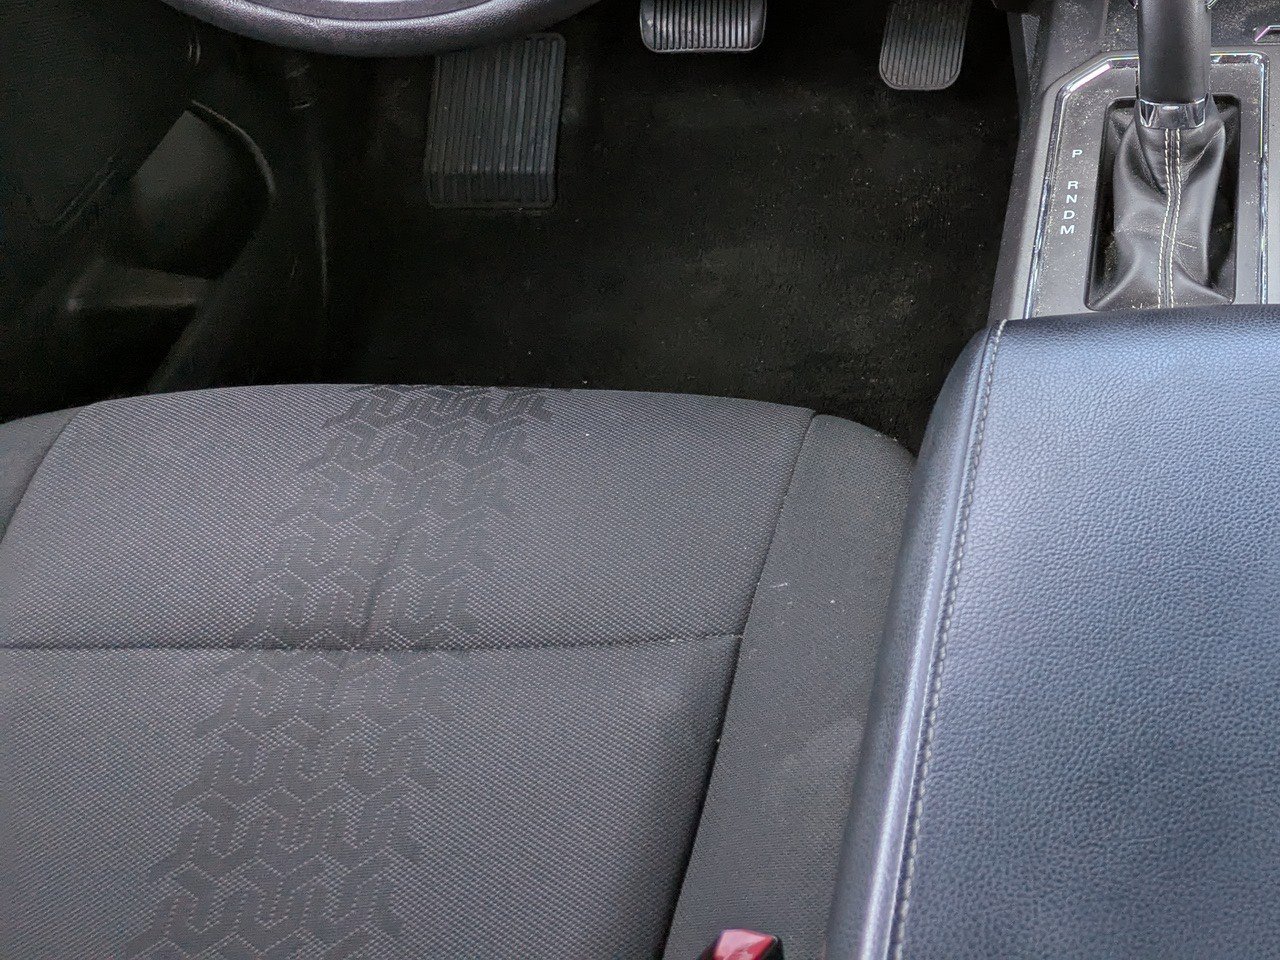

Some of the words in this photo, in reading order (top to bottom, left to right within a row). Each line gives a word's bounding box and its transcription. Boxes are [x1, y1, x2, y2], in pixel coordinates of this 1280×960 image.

[1072, 149, 1082, 158] P
[1068, 181, 1078, 189] R
[1066, 194, 1077, 203] N
[1064, 211, 1075, 219] D
[1060, 225, 1075, 234] M
